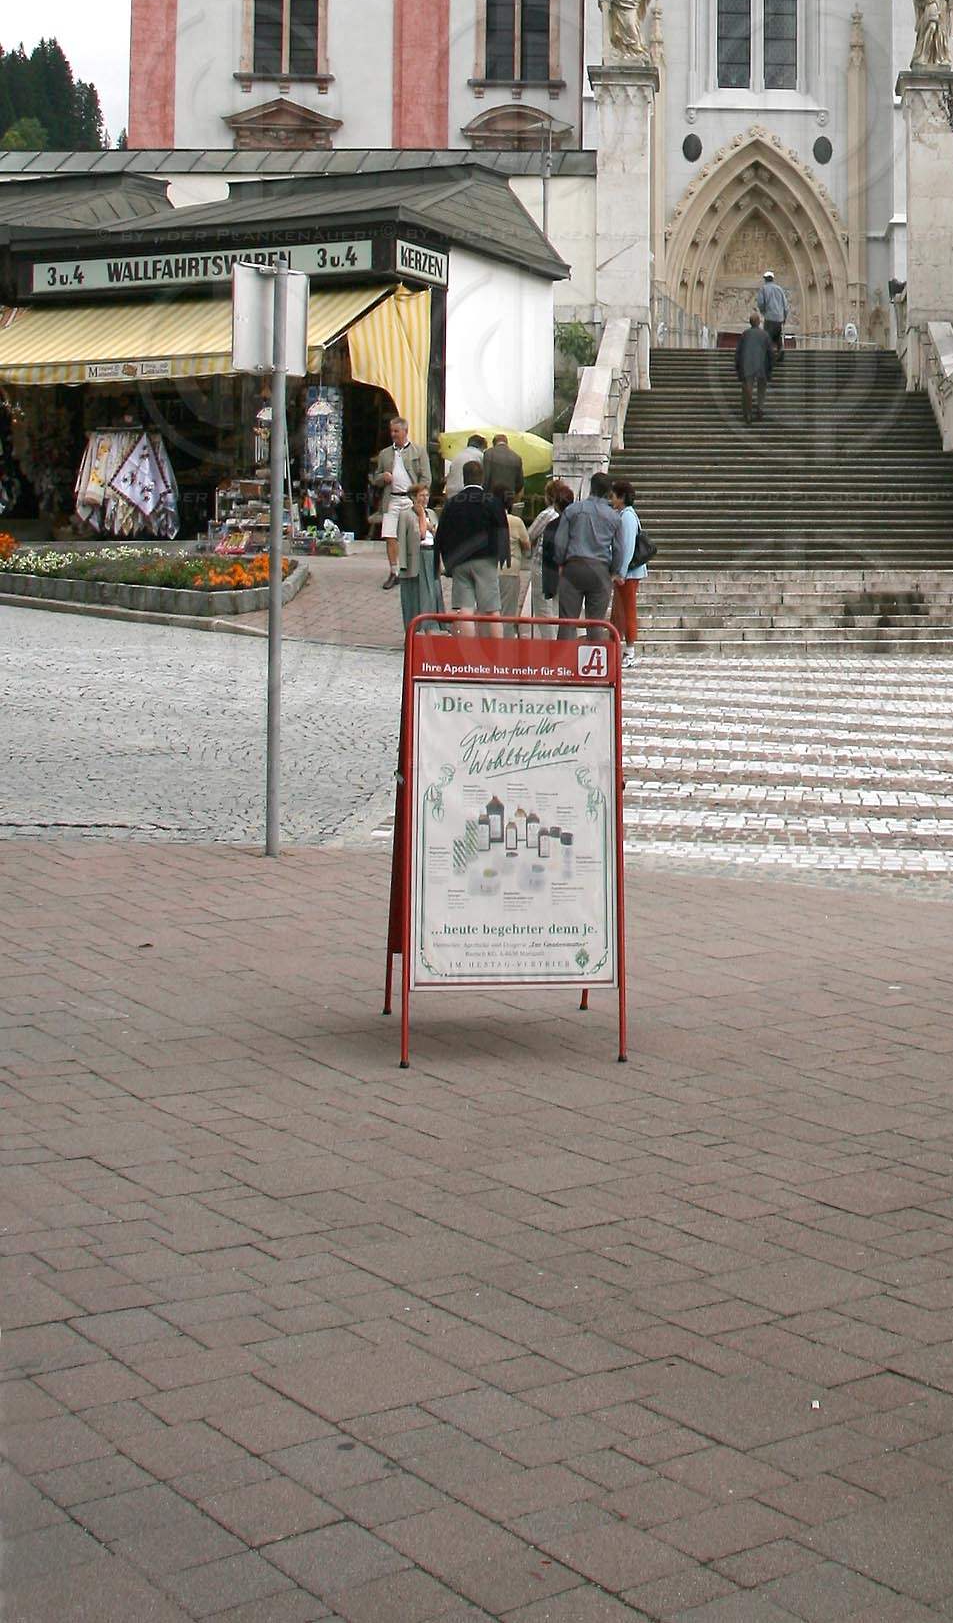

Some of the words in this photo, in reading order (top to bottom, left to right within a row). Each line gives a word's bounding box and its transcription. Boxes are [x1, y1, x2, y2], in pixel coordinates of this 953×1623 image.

[400, 244, 443, 279] KERZEN
[422, 662, 442, 673] Ihre
[444, 663, 491, 674] Apotheke
[493, 664, 510, 674] hat
[512, 664, 538, 675] mehr
[540, 665, 555, 676] für
[557, 666, 575, 677] Sie.
[505, 720, 536, 746] für
[482, 924, 544, 936] begehrter
[548, 923, 579, 934] denn
[582, 923, 598, 936] je.
